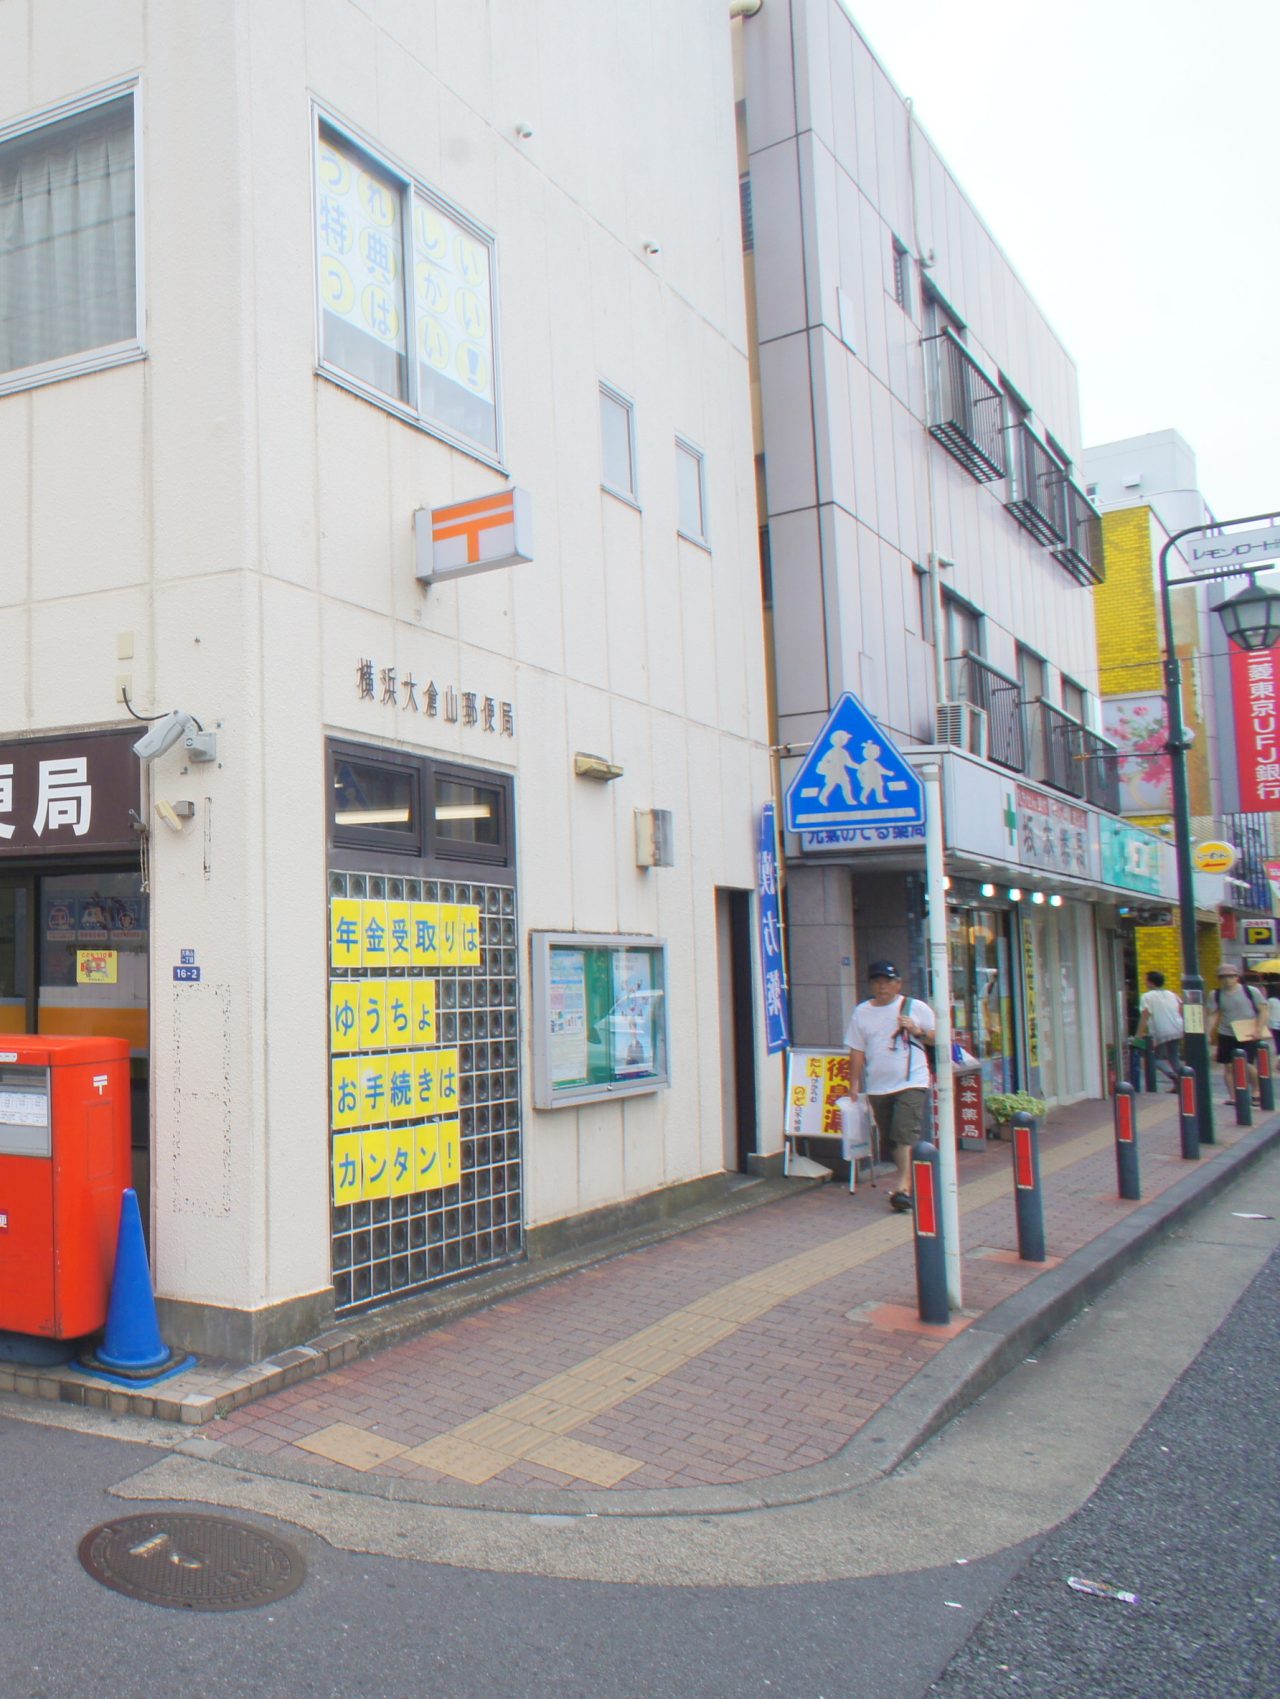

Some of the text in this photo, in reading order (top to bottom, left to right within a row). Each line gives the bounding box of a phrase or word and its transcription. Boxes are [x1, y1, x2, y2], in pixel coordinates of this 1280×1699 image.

[356, 657, 514, 739] 横浜大倉山郵便局
[336, 916, 478, 953] 年金受取りは
[1248, 927, 1270, 945] P
[176, 969, 198, 979] 16-2
[335, 997, 431, 1037] ゆうちょ
[337, 1066, 456, 1114] お手続きは
[339, 1141, 452, 1189] カンタン!
